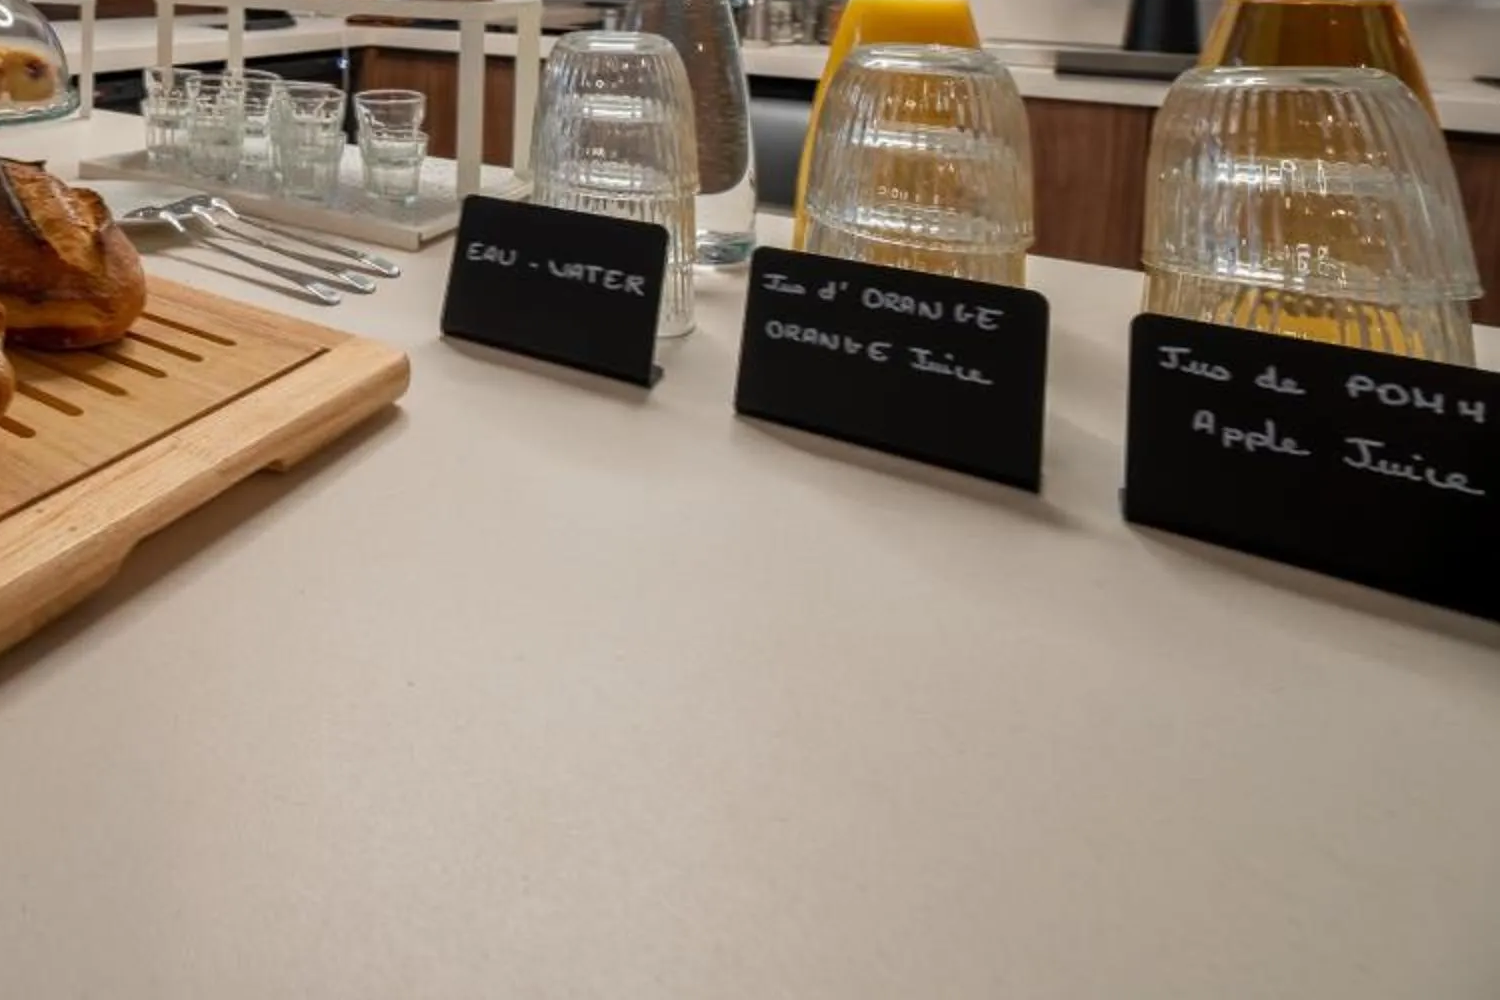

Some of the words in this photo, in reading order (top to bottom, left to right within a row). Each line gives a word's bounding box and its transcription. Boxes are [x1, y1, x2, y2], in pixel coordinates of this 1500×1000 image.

[465, 241, 518, 267] EAU
[547, 258, 646, 297] WATER
[763, 319, 893, 362] ORANGE
[1253, 364, 1307, 395] de
[1191, 408, 1313, 457] Apple
[1342, 436, 1486, 496] Juice
